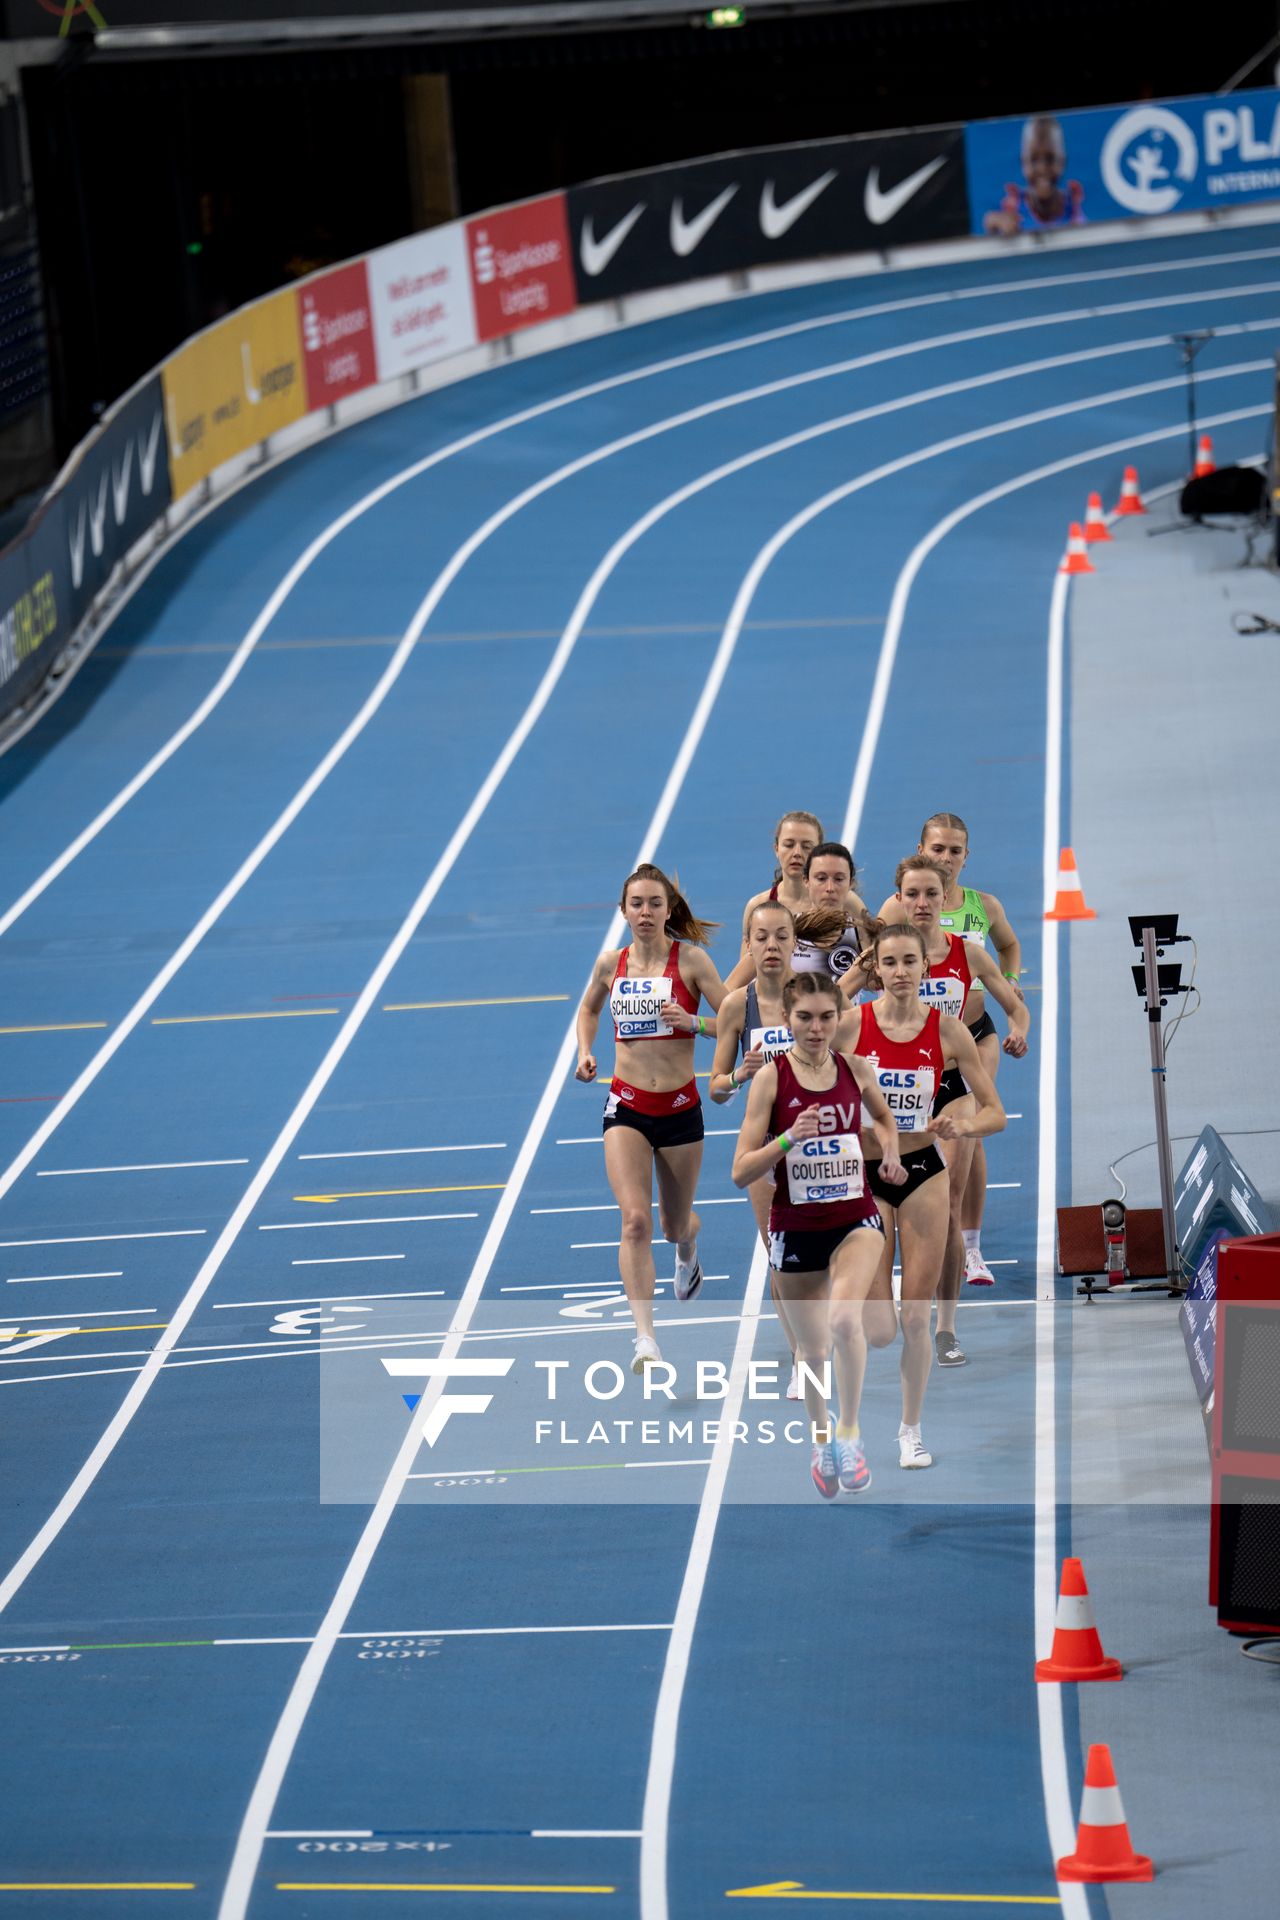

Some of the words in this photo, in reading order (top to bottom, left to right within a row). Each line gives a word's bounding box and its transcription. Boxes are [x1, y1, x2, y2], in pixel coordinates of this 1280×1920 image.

[882, 1093, 924, 1110] EISL
[818, 1103, 855, 1133] SV
[792, 1159, 859, 1180] COUTELLIER
